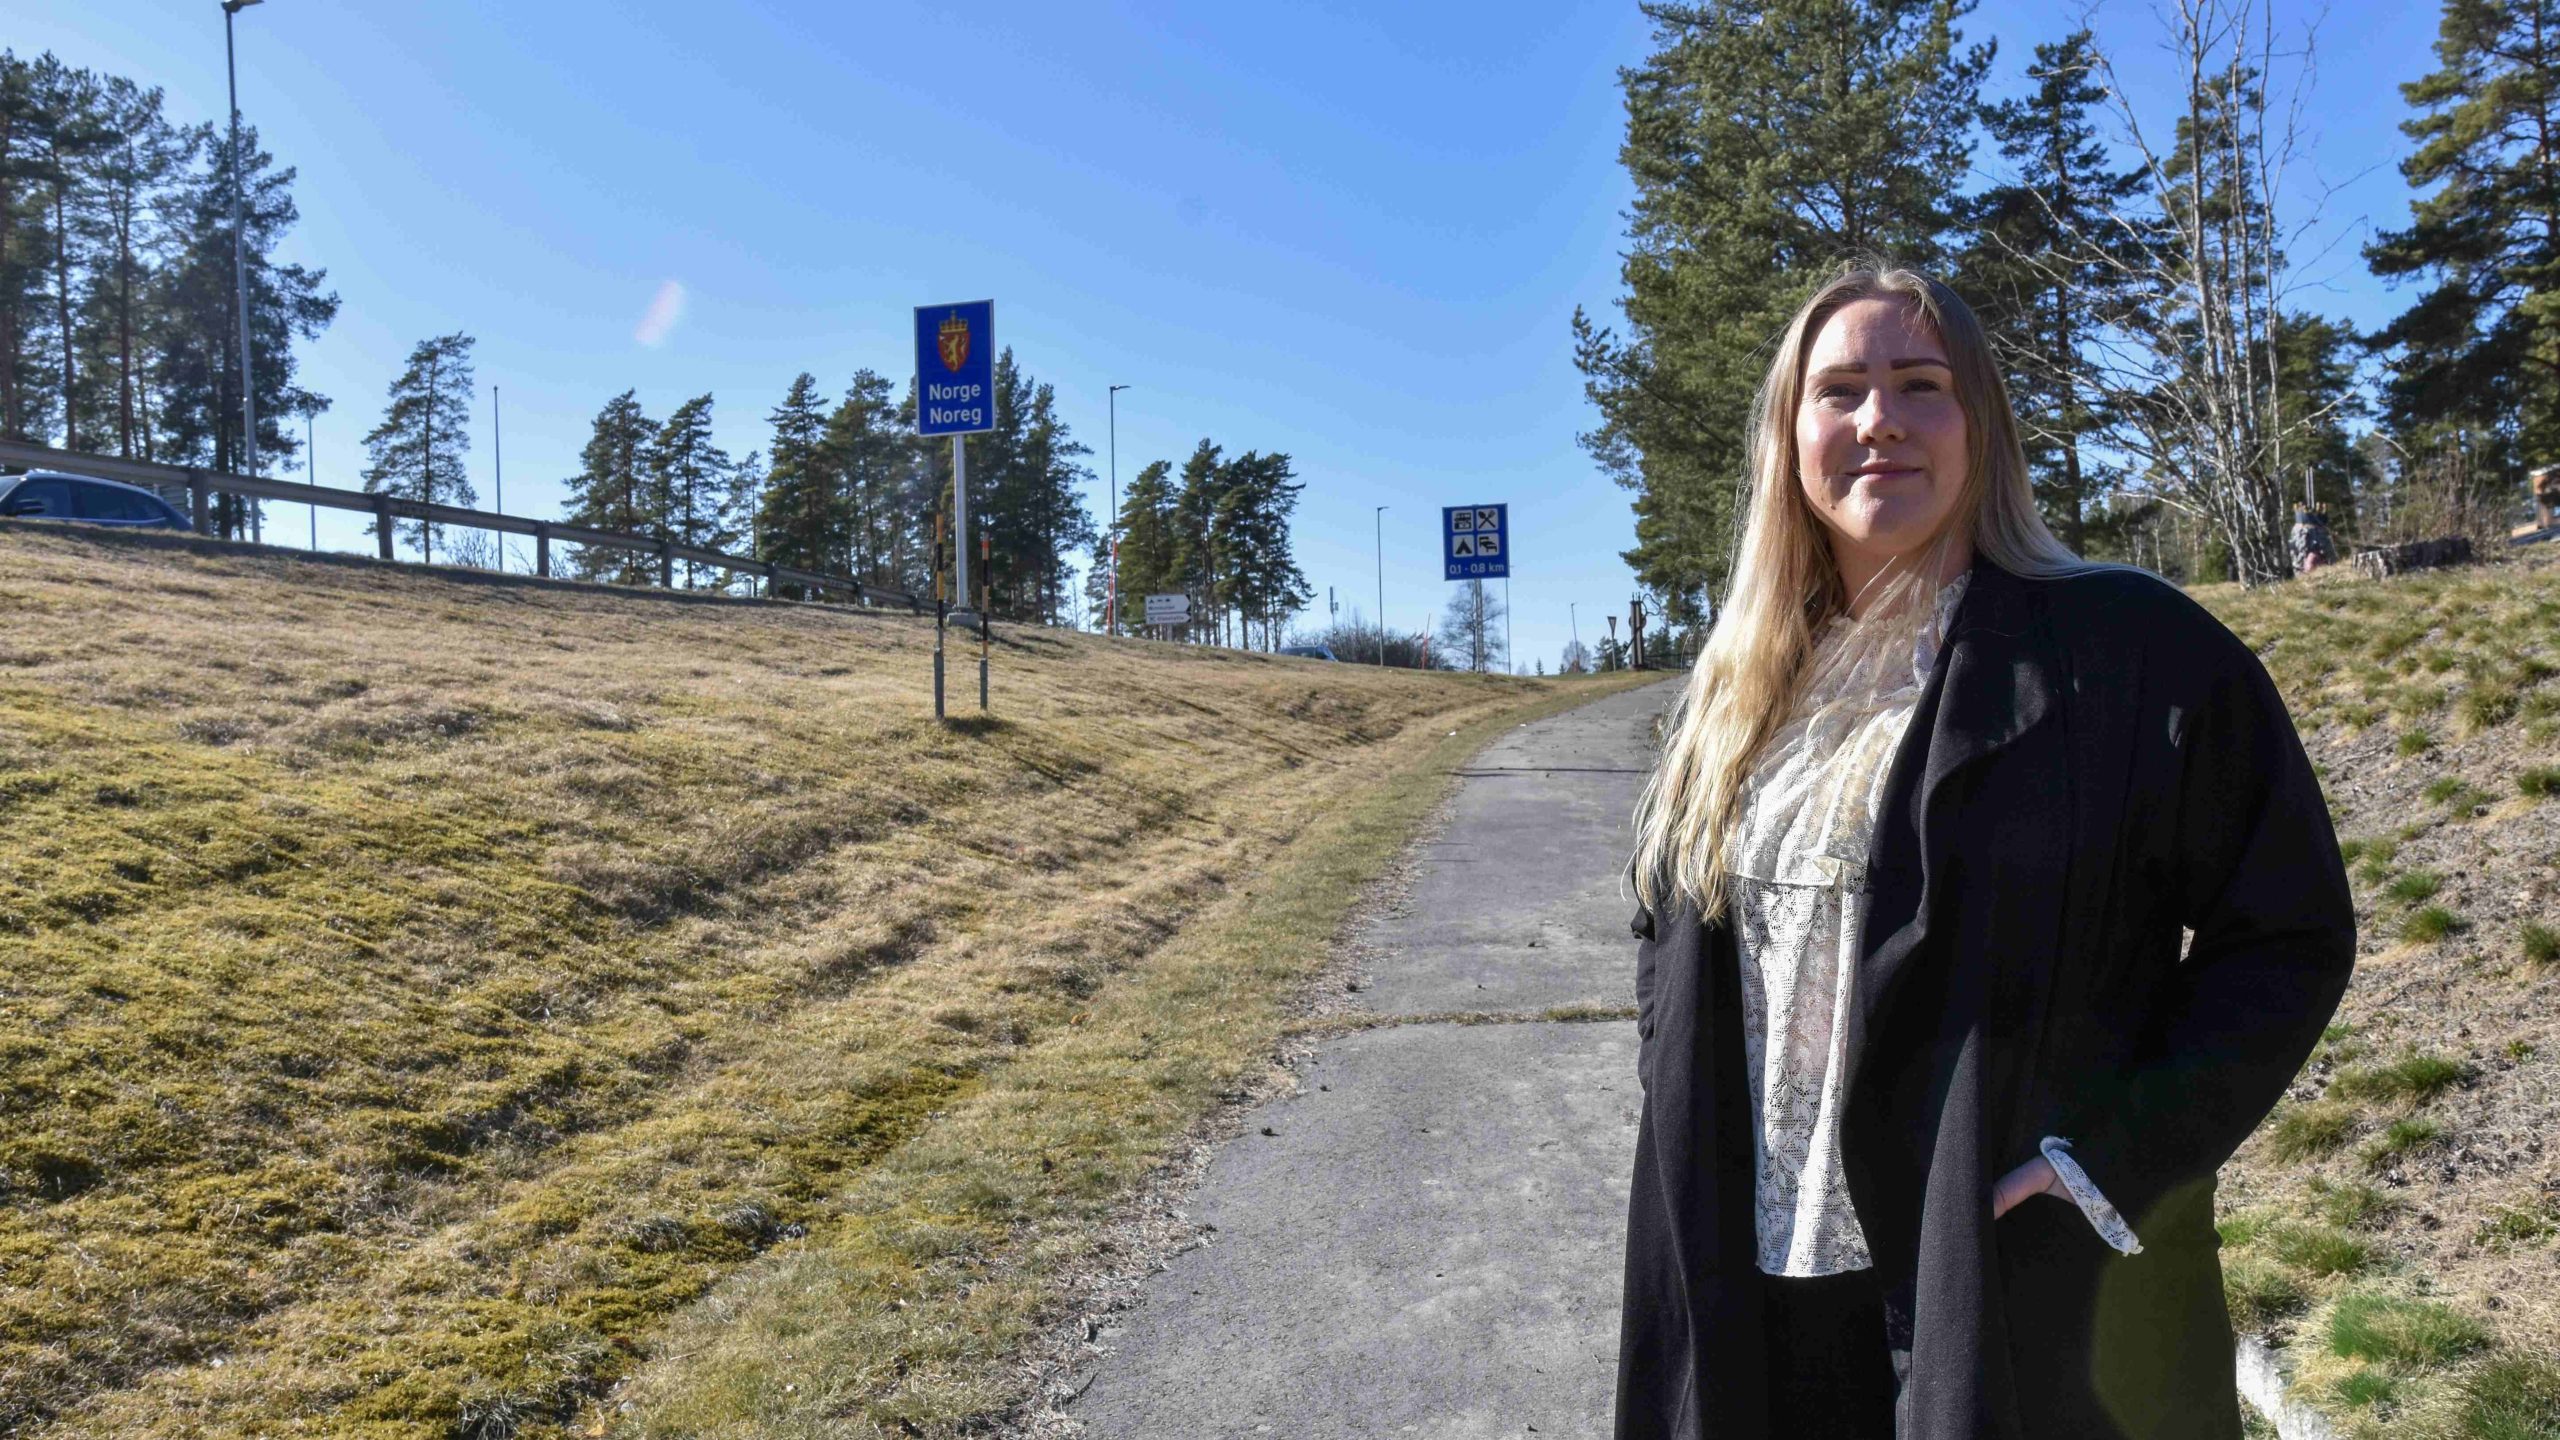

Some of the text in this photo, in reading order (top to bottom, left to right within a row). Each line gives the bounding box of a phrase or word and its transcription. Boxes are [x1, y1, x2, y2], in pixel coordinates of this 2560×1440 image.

[929, 383, 981, 402] Norge
[930, 407, 982, 425] Noreg
[1488, 562, 1505, 573] km
